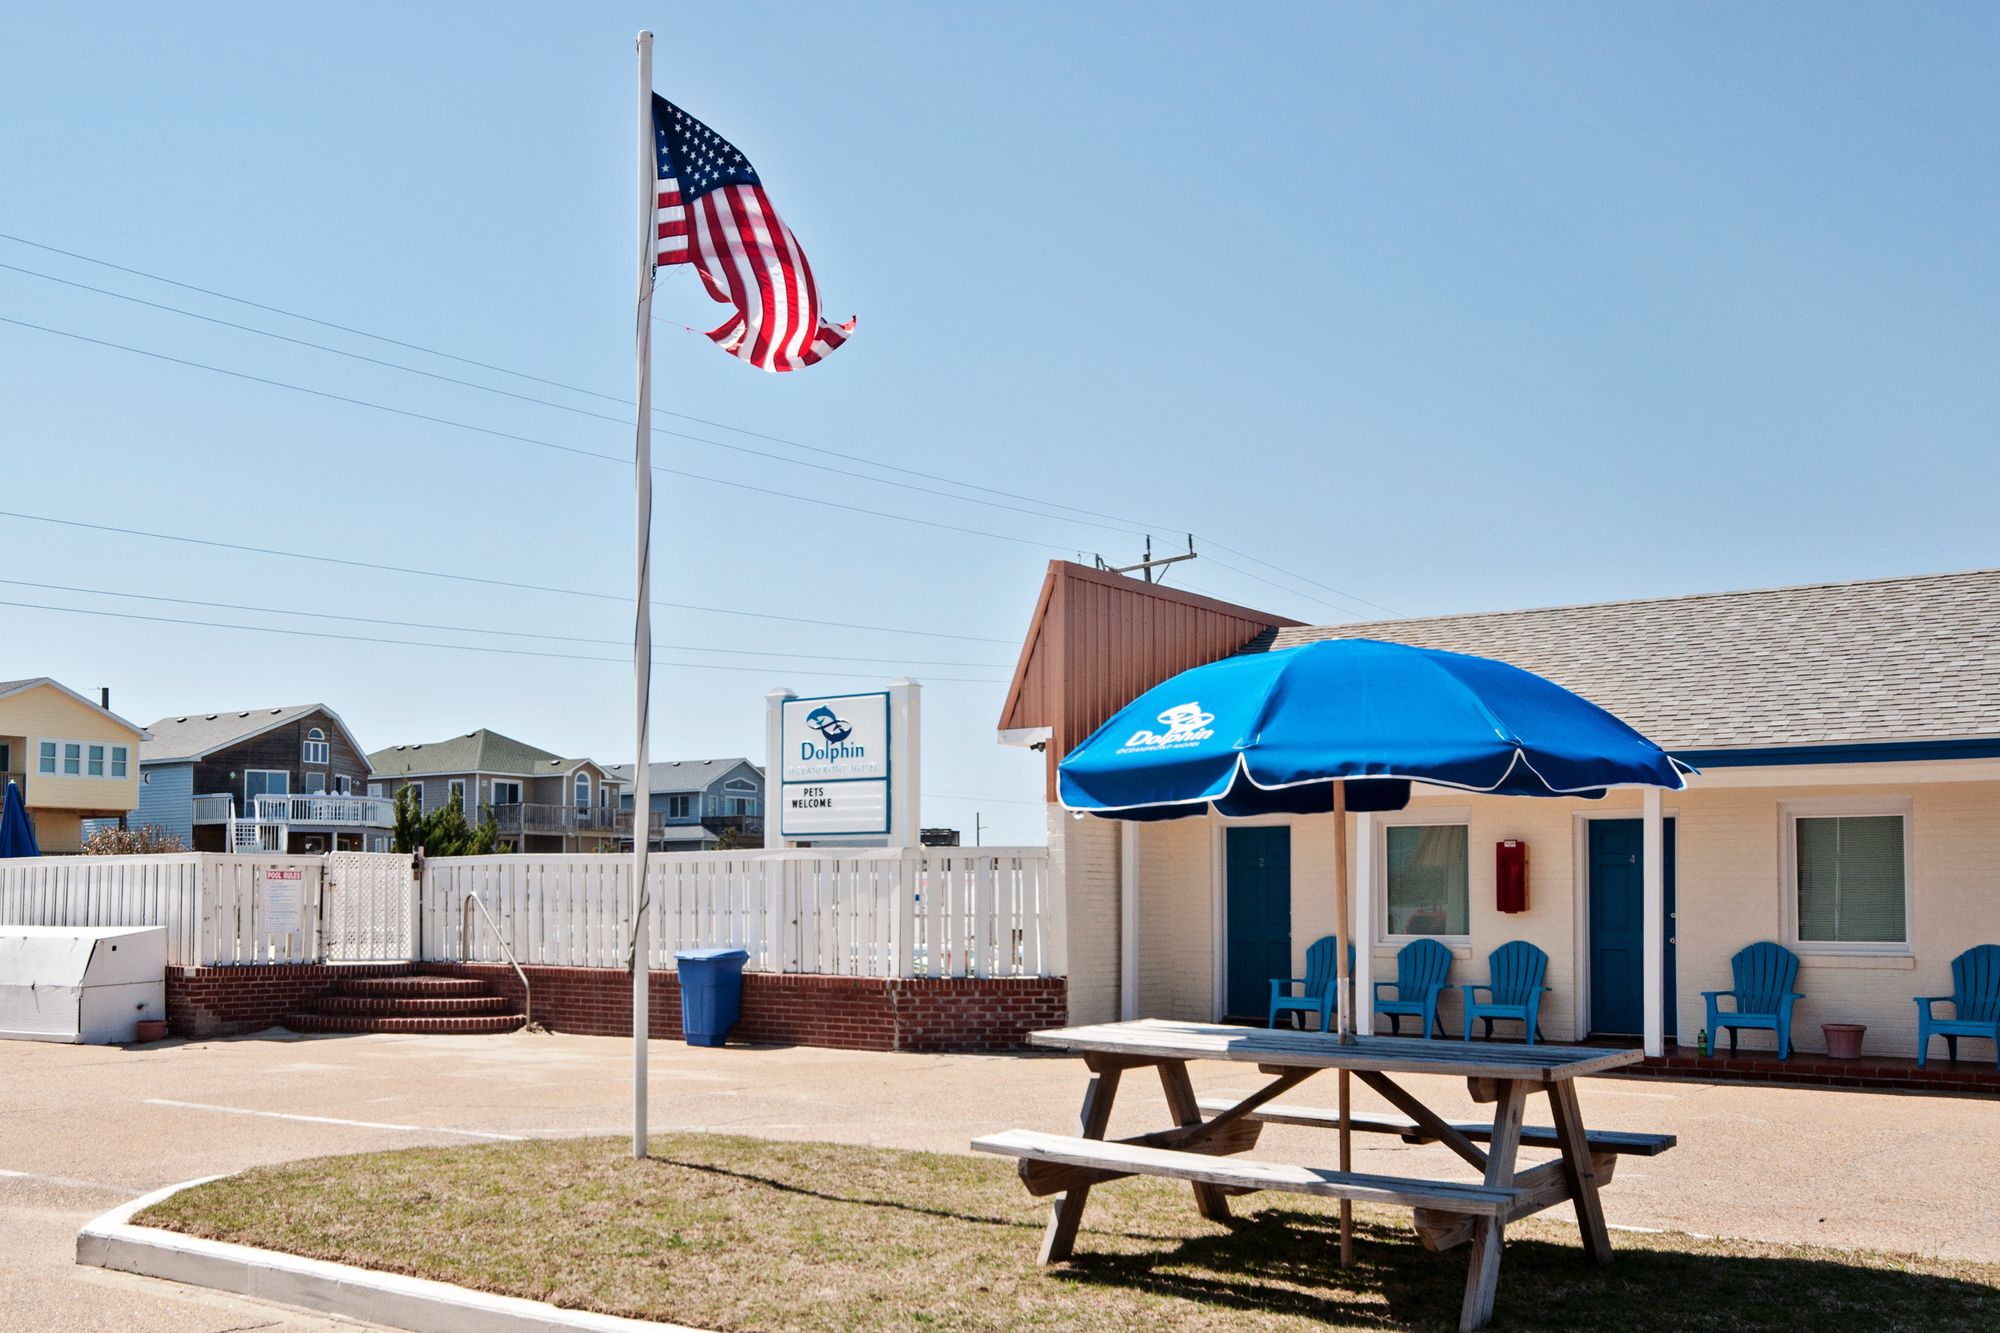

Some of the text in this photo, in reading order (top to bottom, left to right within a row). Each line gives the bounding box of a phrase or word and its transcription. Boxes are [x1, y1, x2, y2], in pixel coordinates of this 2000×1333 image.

[1125, 727, 1214, 748] Dolphin
[801, 740, 864, 763] Dolphin
[803, 787, 824, 797] PETS
[791, 798, 832, 808] WELCOME
[1630, 854, 1636, 864] 4
[267, 871, 301, 879] POOL RULES
